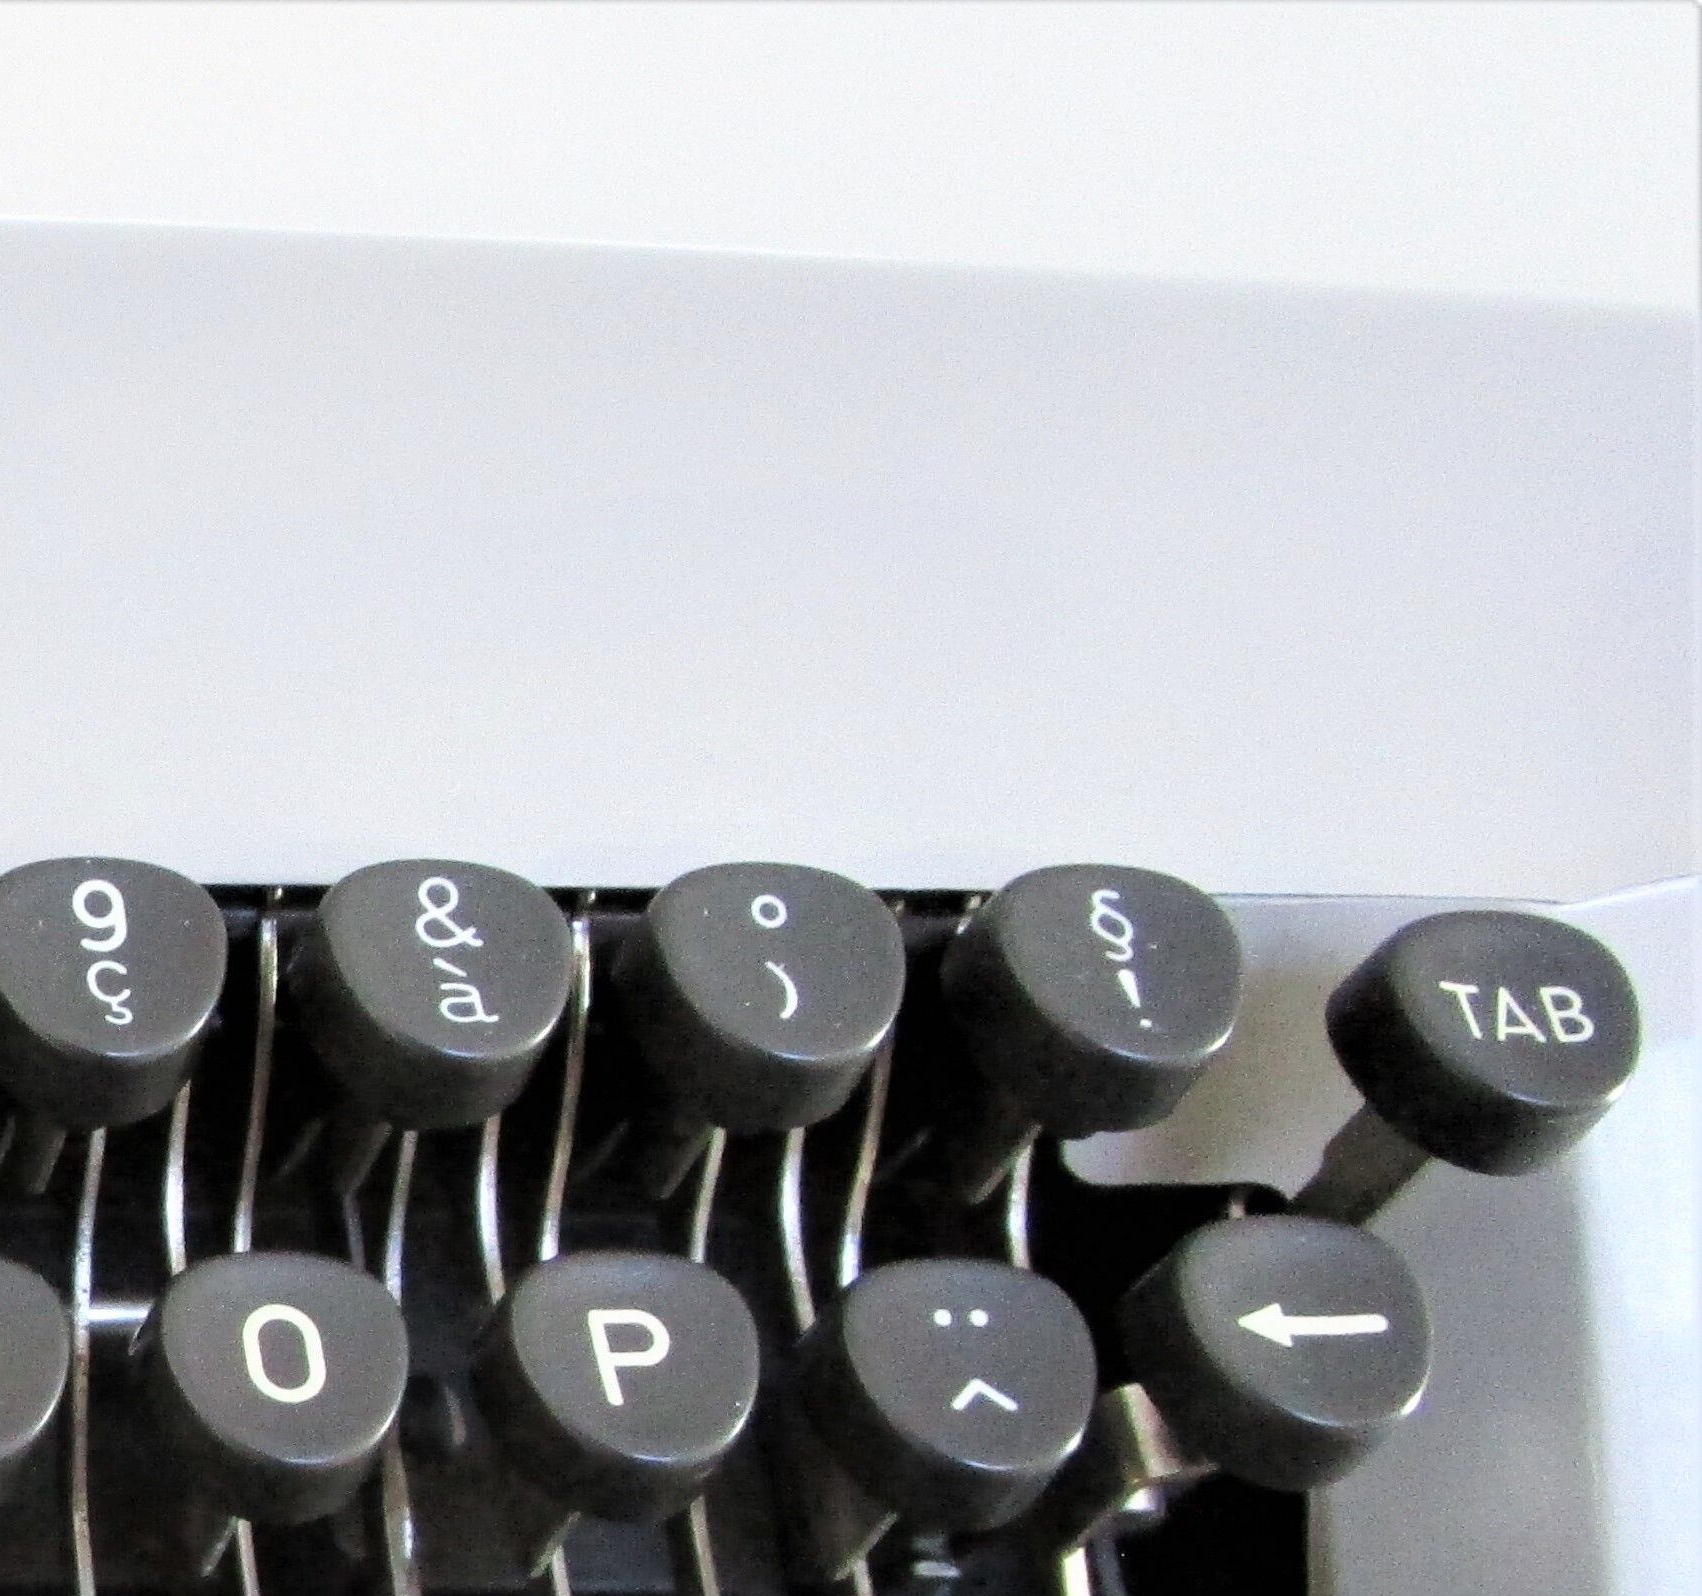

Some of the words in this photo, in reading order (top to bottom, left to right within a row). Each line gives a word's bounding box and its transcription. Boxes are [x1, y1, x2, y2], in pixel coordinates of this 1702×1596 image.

[69, 876, 130, 956] 9
[412, 873, 486, 951] &
[1086, 887, 1136, 960] §
[84, 958, 135, 1027] ç
[431, 954, 502, 1026] à
[1113, 967, 1154, 1031] !
[1437, 978, 1596, 1045] TAB
[238, 1300, 329, 1407] O
[584, 1306, 674, 1408] P
